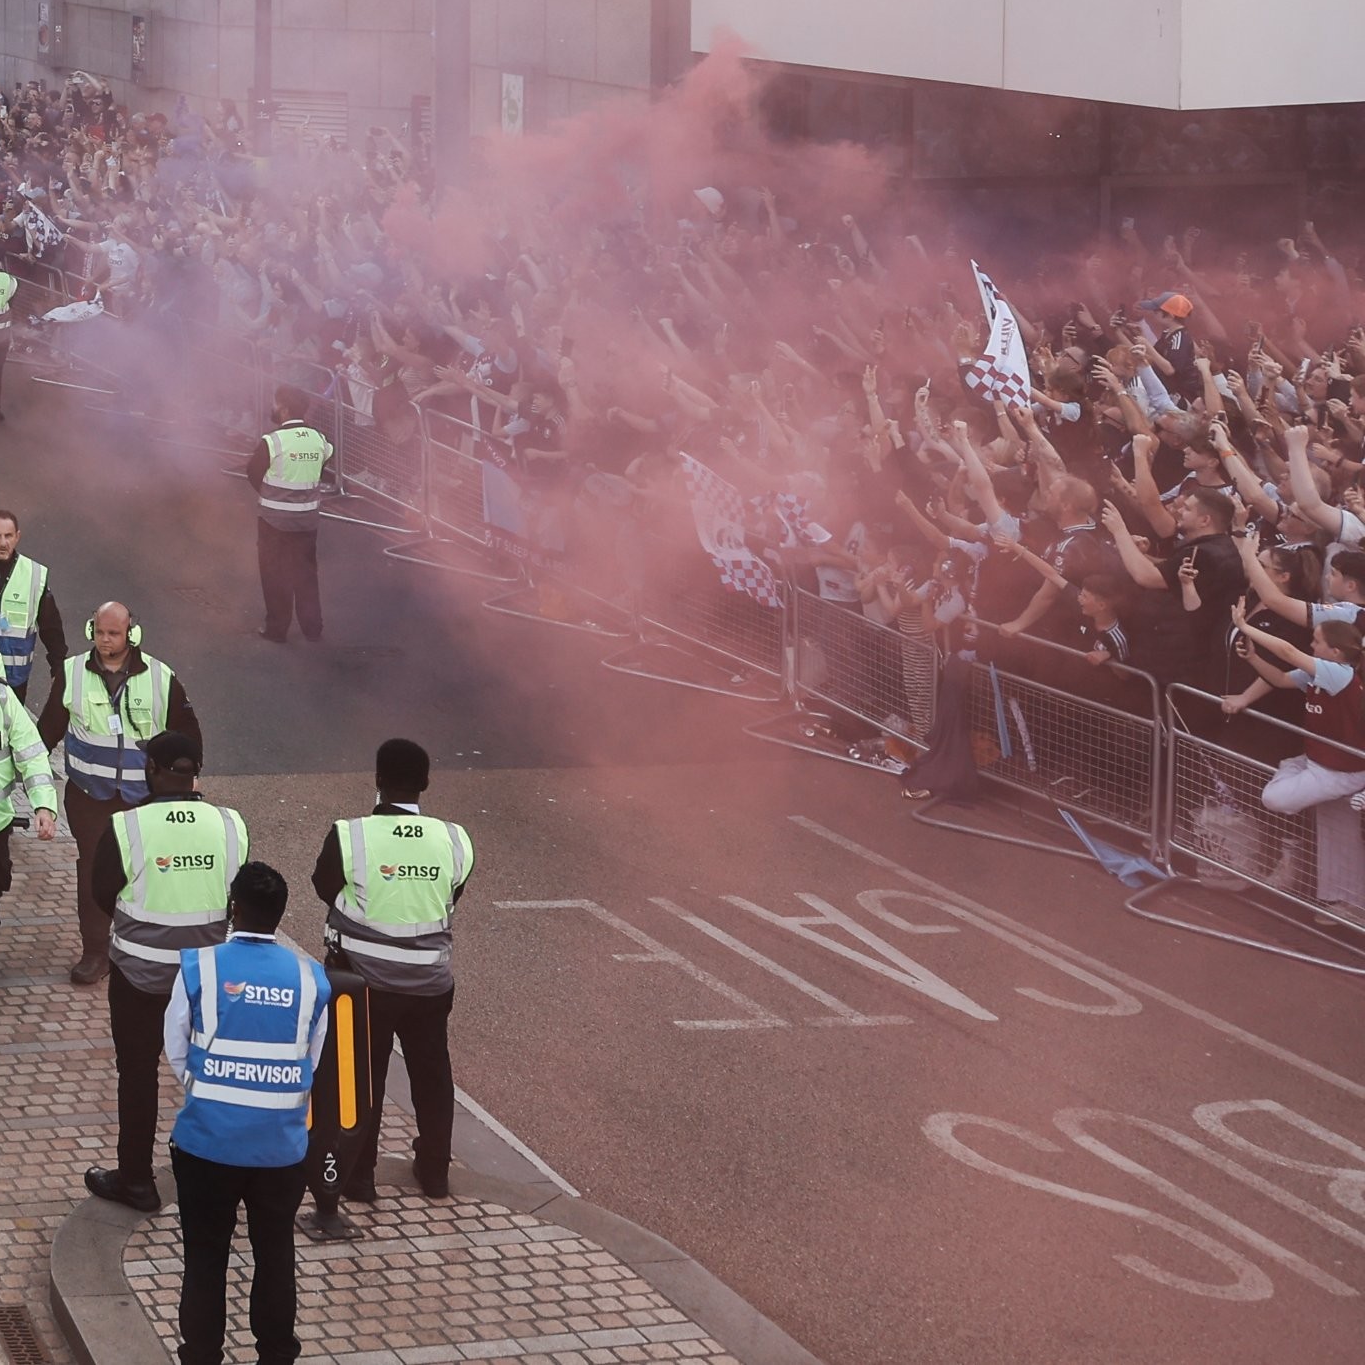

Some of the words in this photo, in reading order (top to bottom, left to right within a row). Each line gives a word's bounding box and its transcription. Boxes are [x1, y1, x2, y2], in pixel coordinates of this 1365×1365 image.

[299, 452, 319, 460] snsg
[166, 810, 196, 824] 403
[392, 825, 424, 839] 428
[173, 854, 214, 870] snsg
[398, 865, 441, 881] snsg
[492, 888, 1143, 1030] GATE
[245, 985, 294, 1007] snsg
[204, 1059, 302, 1084] SUPERVISOR
